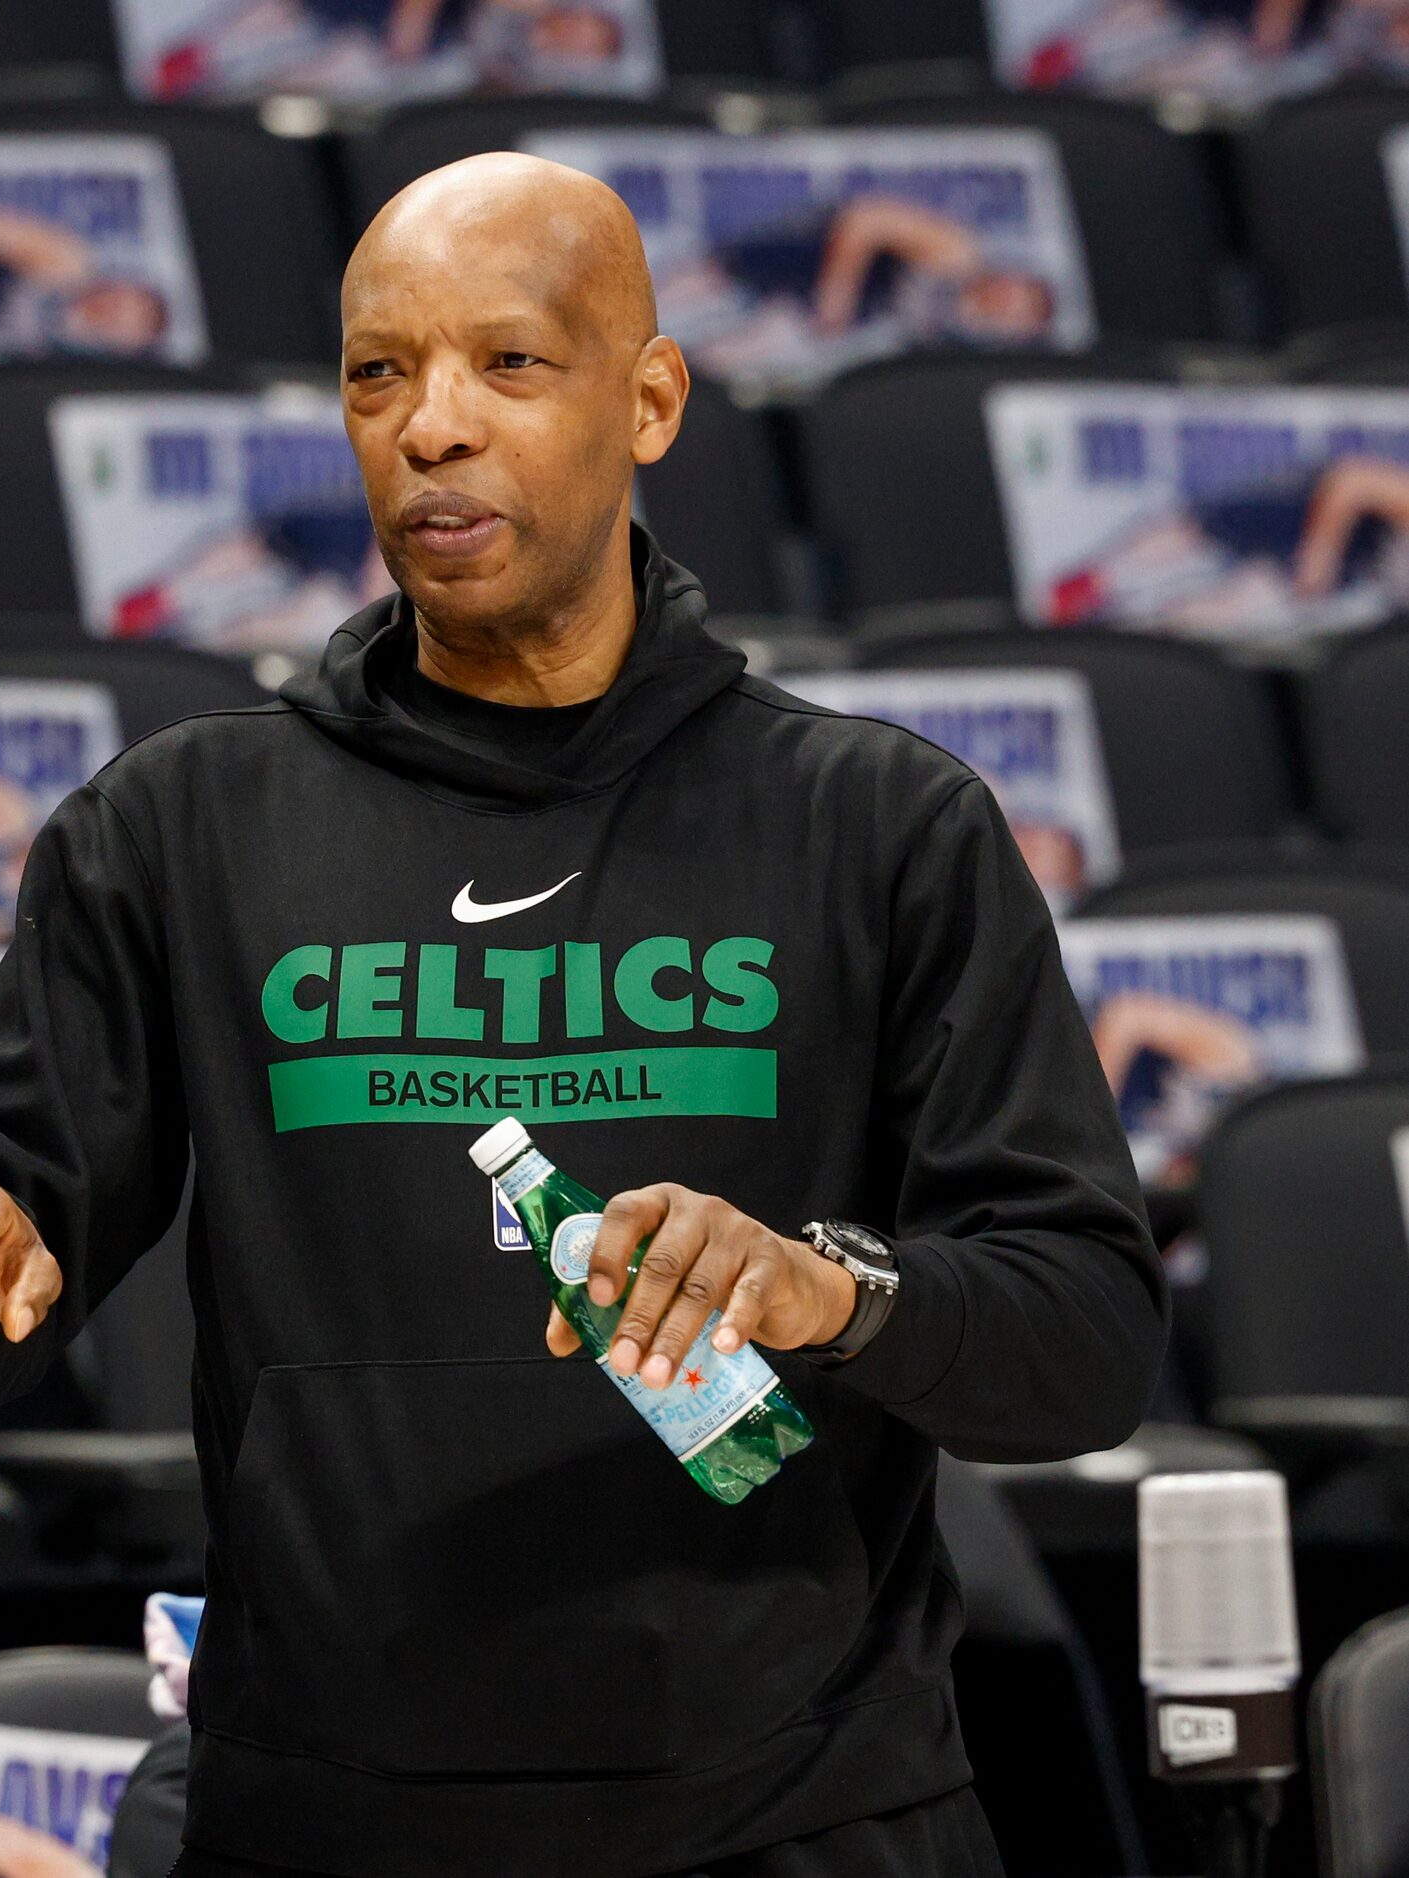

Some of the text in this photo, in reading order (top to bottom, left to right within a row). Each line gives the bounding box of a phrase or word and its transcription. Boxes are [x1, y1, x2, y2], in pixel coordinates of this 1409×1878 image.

[261, 935, 780, 1044] CELTICS
[367, 1064, 662, 1110] BASKETBALL
[500, 1226, 524, 1244] NBA
